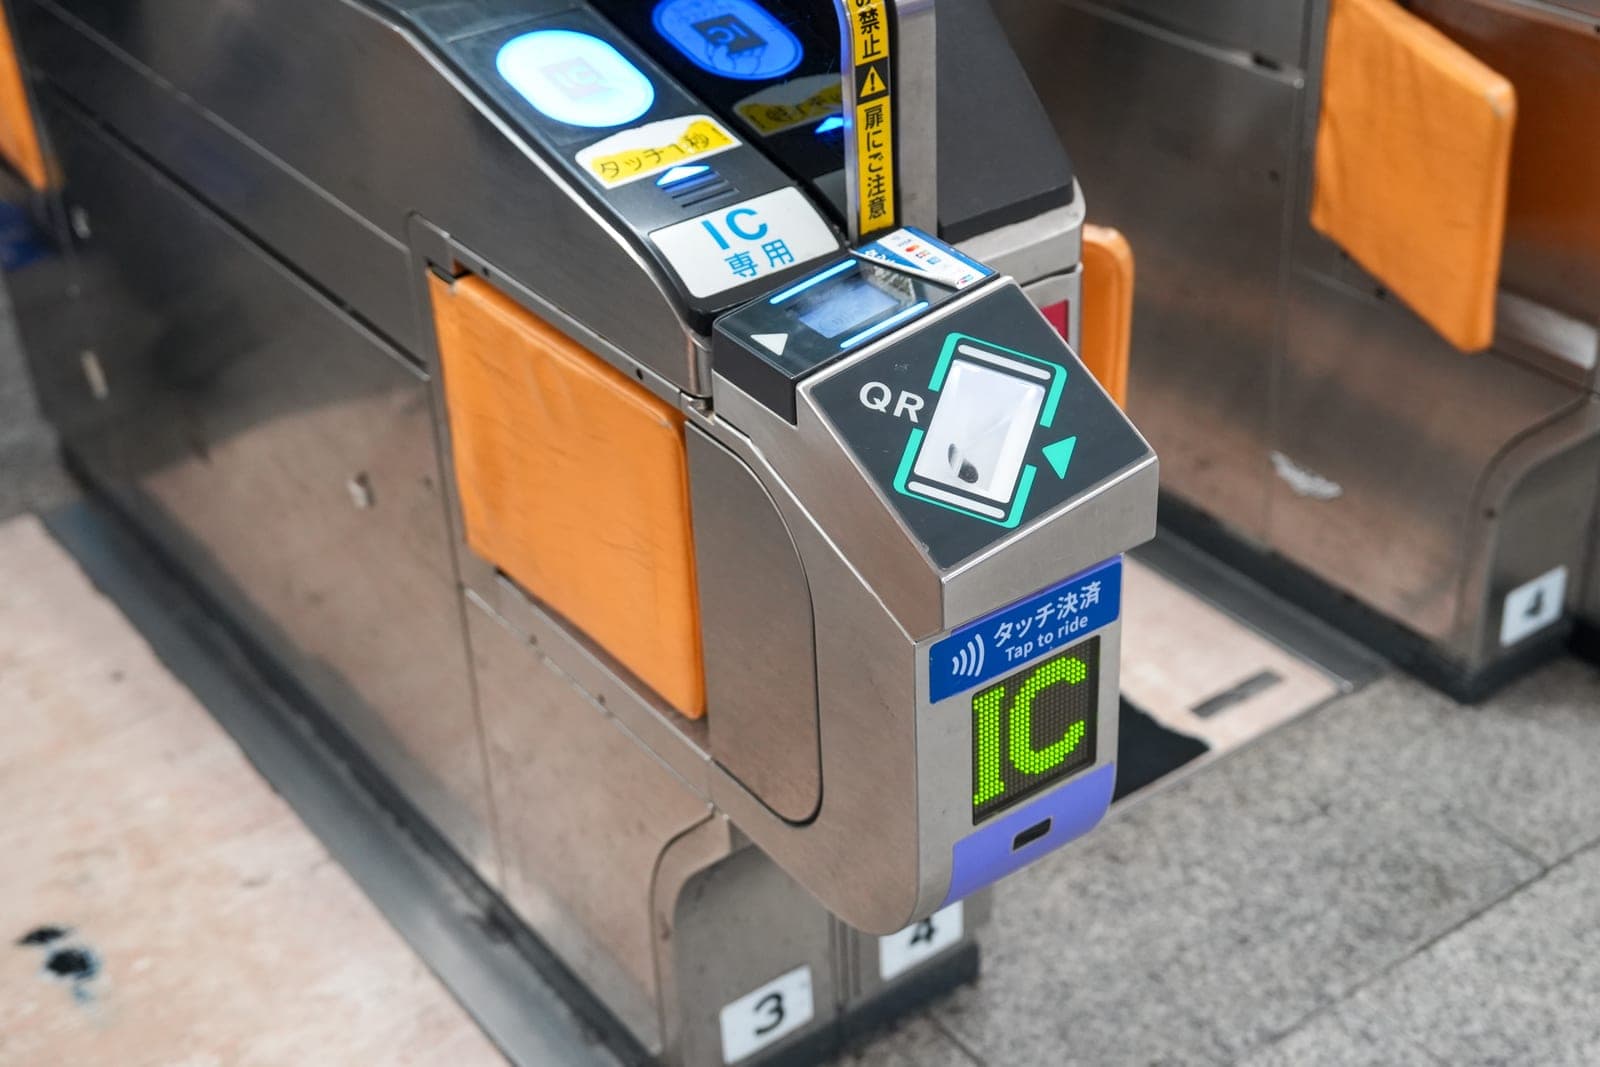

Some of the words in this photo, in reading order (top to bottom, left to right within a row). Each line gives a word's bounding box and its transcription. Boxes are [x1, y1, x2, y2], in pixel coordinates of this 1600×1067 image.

[864, 103, 887, 220] 扉にご注意
[701, 208, 768, 250] IC
[724, 239, 795, 278] 専用
[859, 381, 925, 423] QR
[993, 580, 1102, 648] タッチ決済
[1005, 643, 1033, 663] Tap
[1038, 631, 1054, 646] to
[1058, 615, 1089, 639] ride
[972, 656, 1087, 806] IC
[910, 916, 936, 947] 4
[754, 992, 785, 1036] 3
